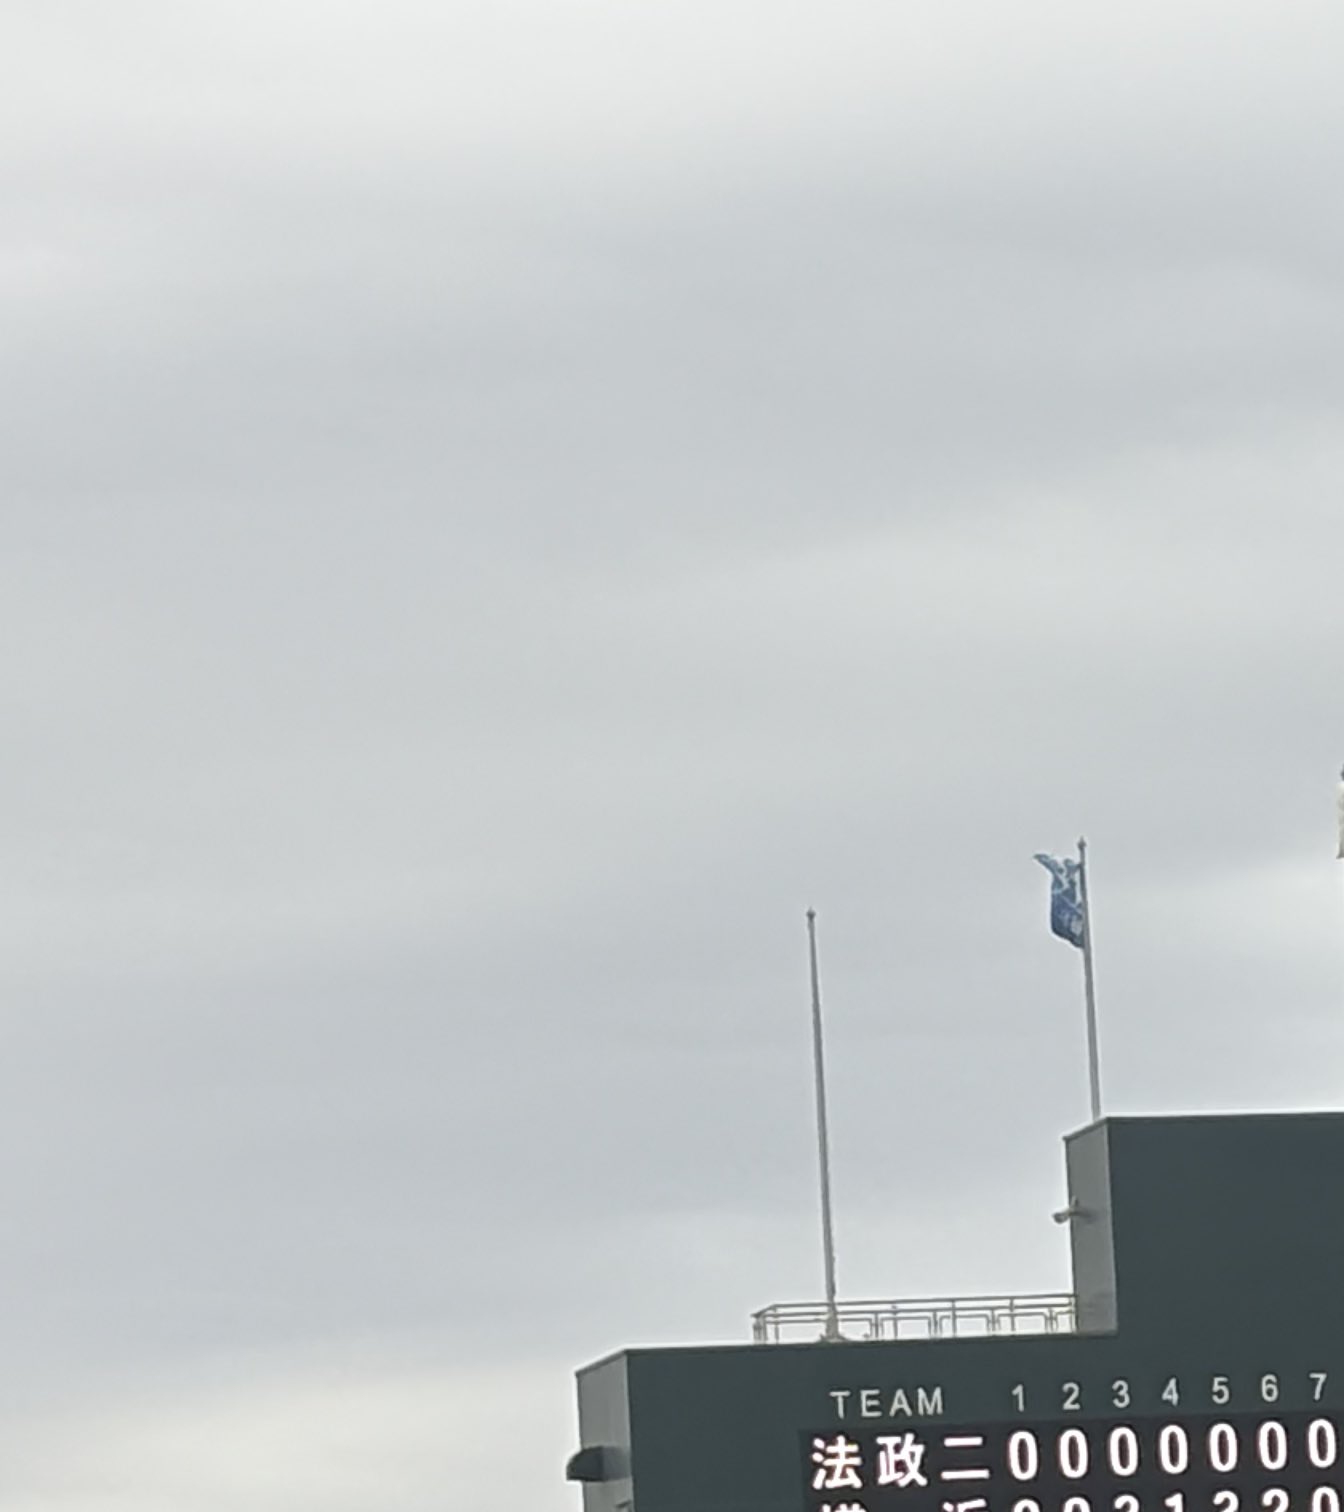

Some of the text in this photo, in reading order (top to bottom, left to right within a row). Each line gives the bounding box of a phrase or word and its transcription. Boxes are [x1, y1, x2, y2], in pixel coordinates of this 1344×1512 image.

[830, 1388, 942, 1418] TEAM
[1013, 1385, 1024, 1411] 1
[1063, 1383, 1080, 1409] 2
[1113, 1381, 1129, 1408] 3
[1162, 1378, 1178, 1405] 4
[1213, 1377, 1229, 1403] 5
[1262, 1375, 1278, 1402] 6
[1310, 1373, 1326, 1400] 7
[812, 1433, 989, 1489] 法政二
[1009, 1431, 1037, 1480] 0
[1059, 1429, 1088, 1478] 0
[1110, 1427, 1138, 1476] 0
[1160, 1425, 1188, 1474] 0
[1209, 1423, 1237, 1472] 0
[1258, 1421, 1287, 1470] 0
[1308, 1419, 1336, 1468] 0
